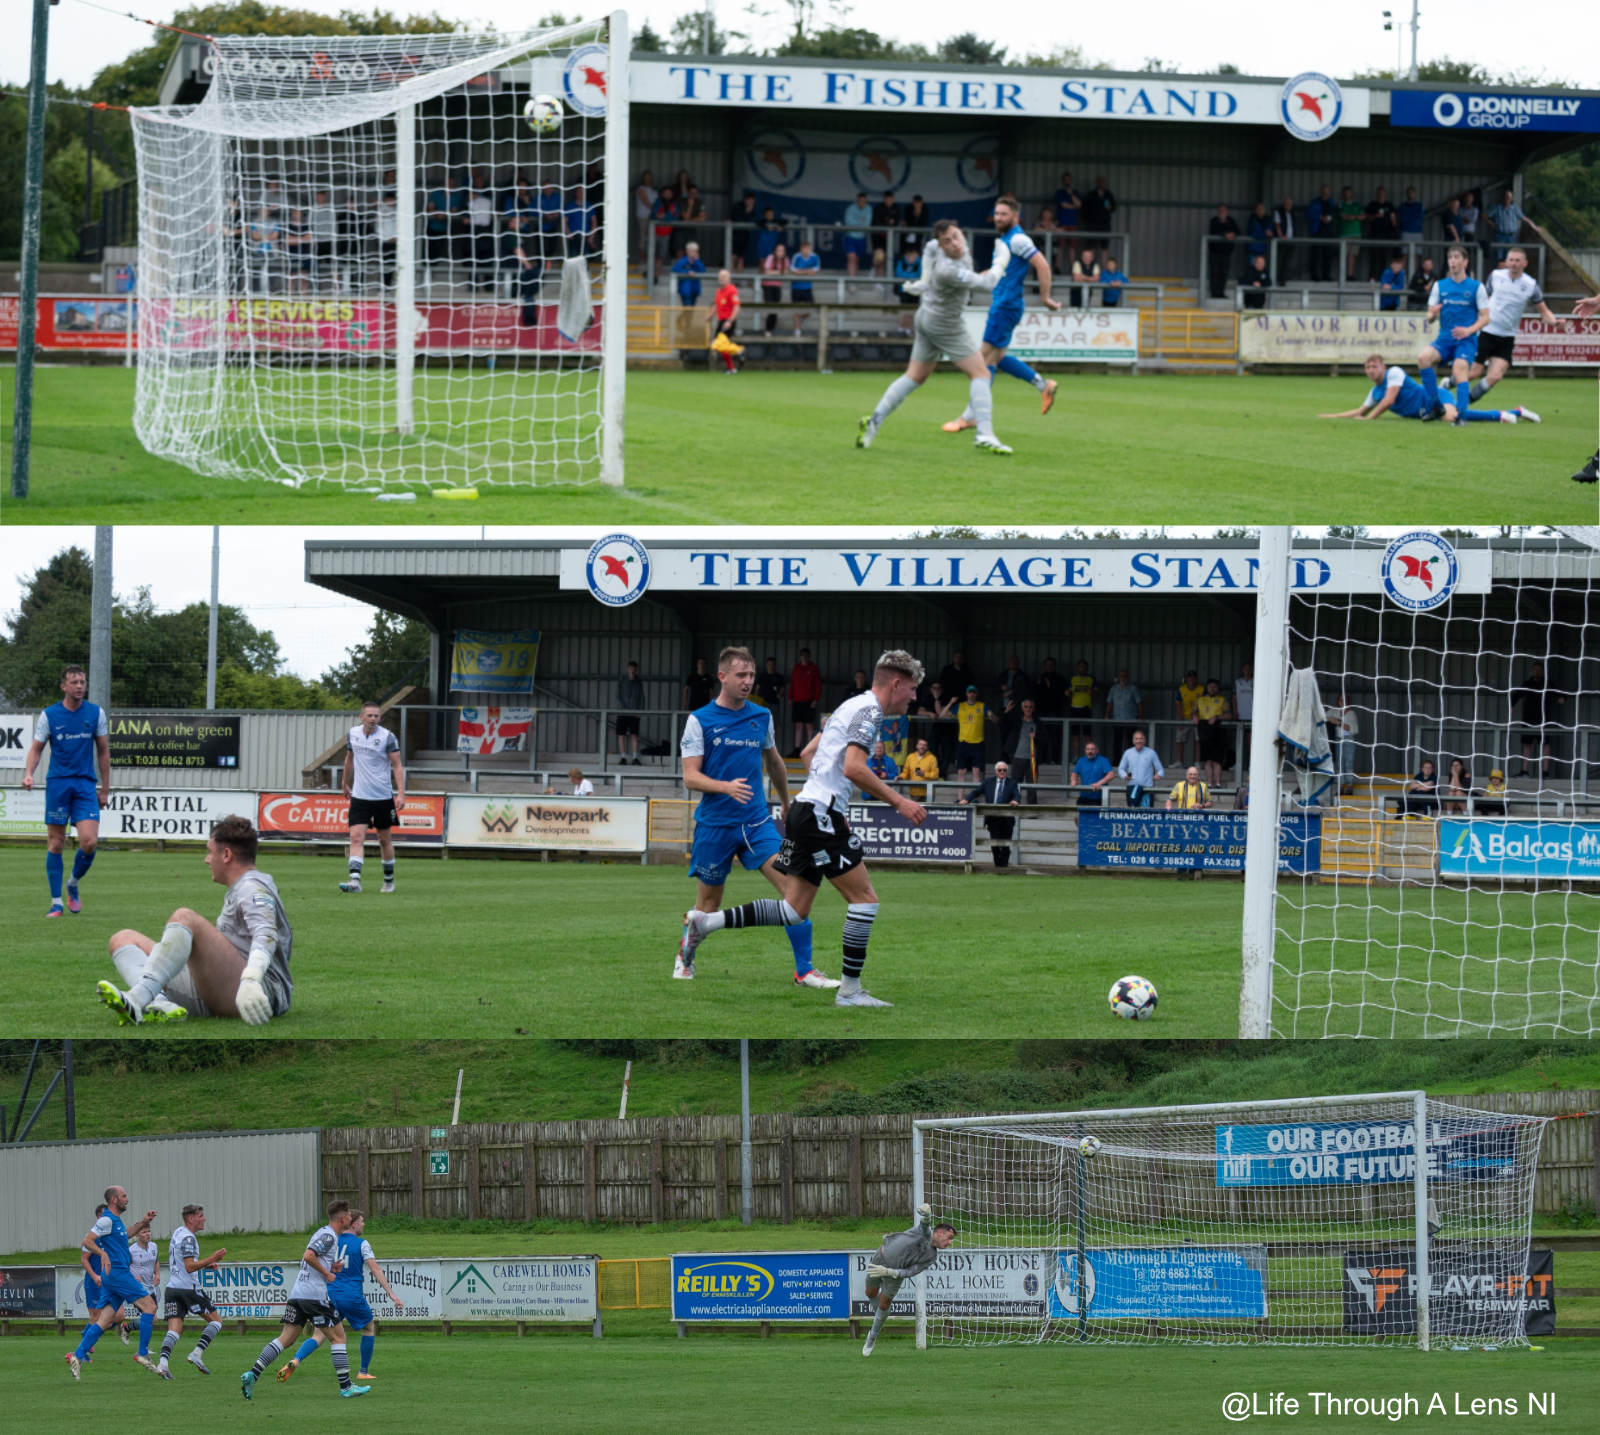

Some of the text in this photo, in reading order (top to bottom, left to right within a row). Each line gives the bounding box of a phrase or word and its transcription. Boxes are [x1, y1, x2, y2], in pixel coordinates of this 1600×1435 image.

[669, 67, 792, 102] THE
[821, 72, 1026, 110] FISHER
[1060, 80, 1238, 118] STAND
[1468, 97, 1581, 116] DONNELLY
[1467, 114, 1531, 128] GROUP
[237, 300, 355, 321] SERVICES
[1255, 315, 1433, 334] MANOR HOUSE
[1016, 331, 1088, 346] SPAR
[690, 552, 809, 587] THE
[839, 553, 1093, 588] VILLAGE
[155, 724, 171, 736] on
[175, 721, 194, 736] the
[197, 725, 233, 740] green
[157, 740, 185, 750] coffee
[526, 805, 610, 826] Newpark
[1165, 814, 1205, 822] PREMIER
[1208, 815, 1231, 823] FUEL
[525, 825, 590, 835] Developments
[850, 828, 938, 844] RECTION
[1096, 841, 1121, 851] COAL
[1125, 843, 1181, 853] IMPORTERS
[1184, 844, 1205, 854] AND
[1209, 845, 1226, 855] OIL
[1488, 833, 1573, 858] Balcas
[1107, 855, 1127, 865] TEL:
[1267, 1127, 1316, 1152] OUR
[1290, 1155, 1339, 1180] OUR
[984, 1254, 1040, 1271] HOUSE
[492, 1263, 591, 1278] CAREWELL HOMES
[778, 1268, 844, 1277] DOMESTIC APPLIANCES
[502, 1281, 526, 1294] Caring
[536, 1281, 549, 1292] Our
[550, 1281, 582, 1292] Business
[962, 1274, 1005, 1289] HOME
[232, 1289, 288, 1304] SERVICES
[236, 1305, 252, 1317] 918
[254, 1305, 271, 1317] 607
[690, 1303, 831, 1317] www.electricalappliancesonline.com
[1467, 1300, 1550, 1311] TEAMWEAR
